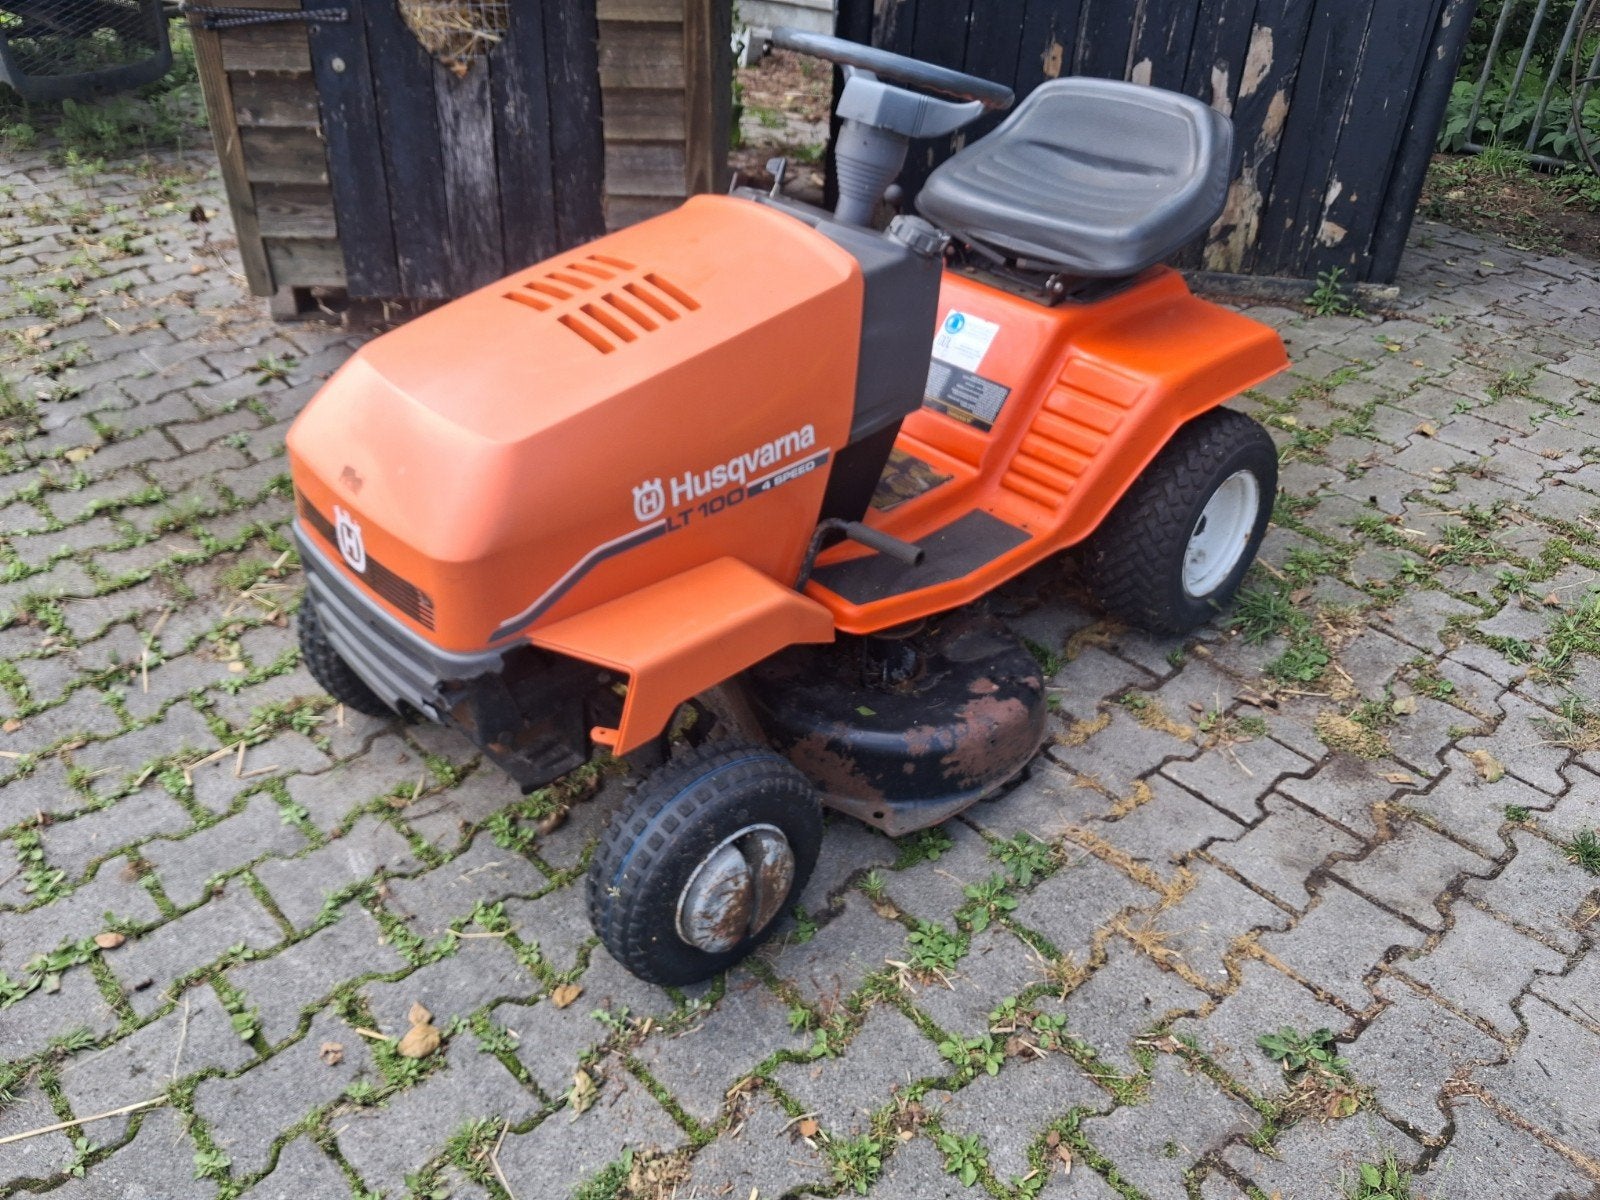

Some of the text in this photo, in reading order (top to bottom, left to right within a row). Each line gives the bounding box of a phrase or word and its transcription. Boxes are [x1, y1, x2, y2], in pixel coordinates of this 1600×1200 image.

[670, 424, 815, 507] Husqvarna
[761, 460, 816, 490] 4 SPEED
[666, 487, 744, 532] LT 100
